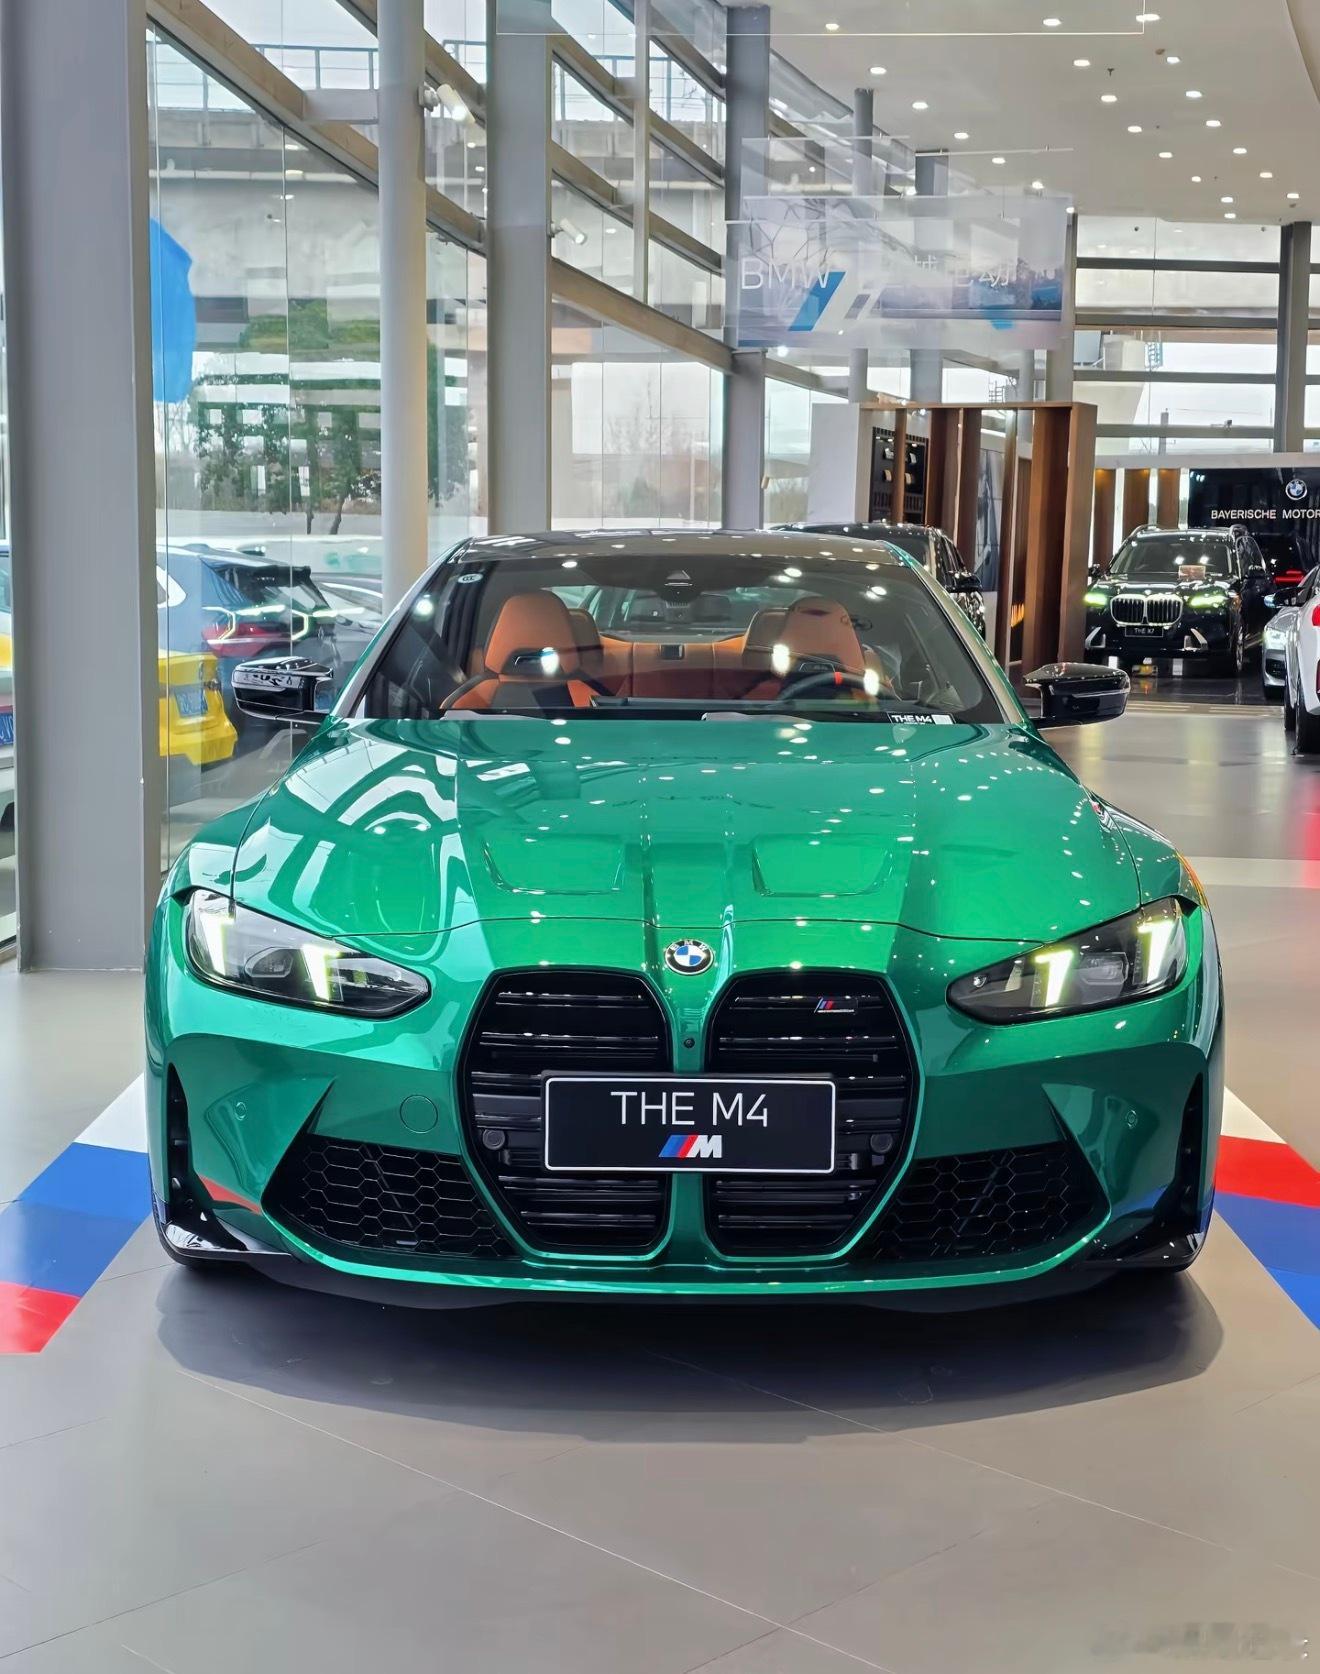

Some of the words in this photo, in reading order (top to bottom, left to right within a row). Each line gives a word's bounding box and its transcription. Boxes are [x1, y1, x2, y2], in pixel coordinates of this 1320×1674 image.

[741, 257, 829, 290] BMW
[1210, 509, 1277, 520] BAYERISCHE
[1282, 509, 1320, 520] MOTOR
[891, 714, 914, 722] THE
[915, 715, 932, 723] M4
[610, 1091, 695, 1126] THE
[712, 1092, 768, 1128] M4
